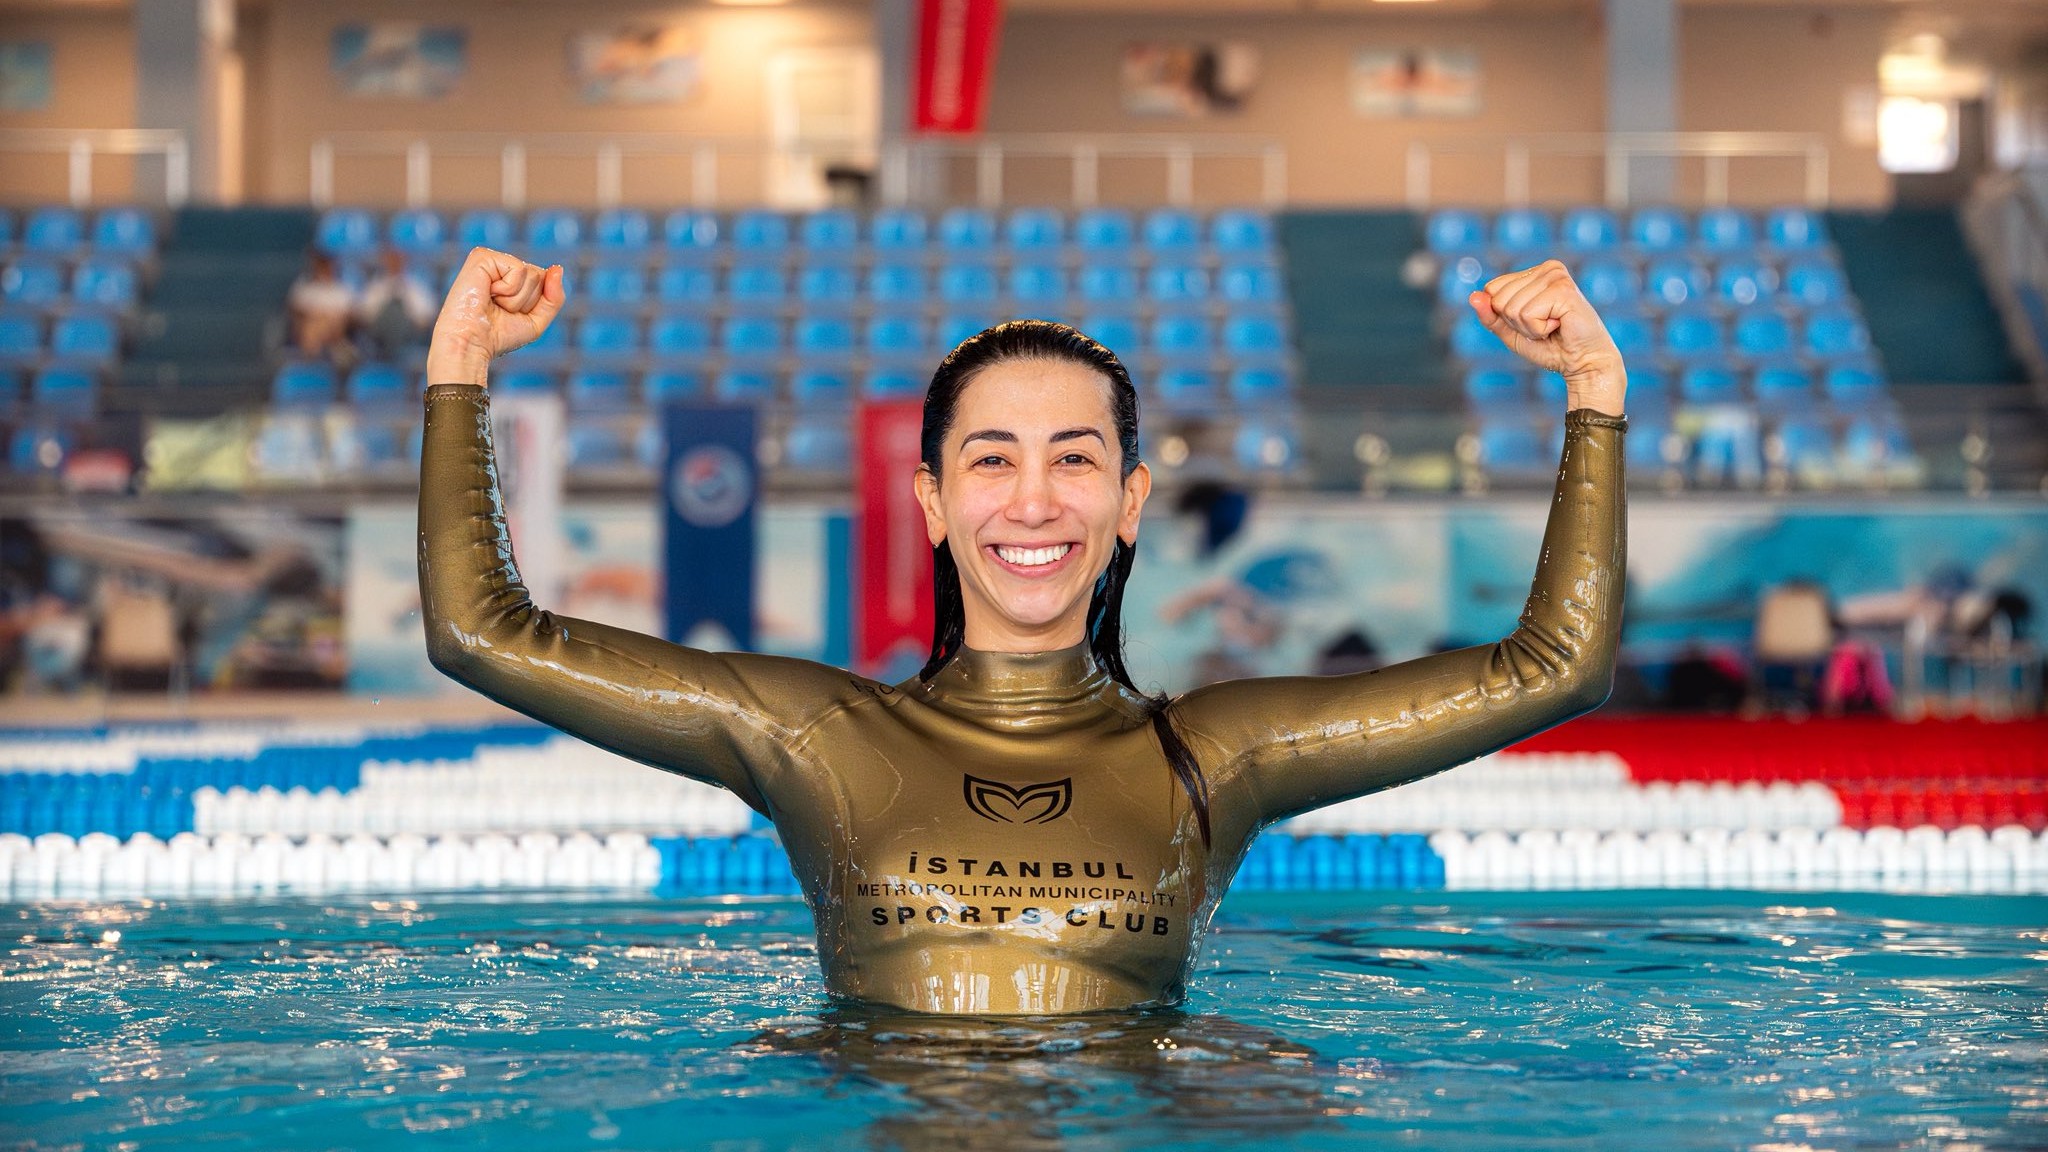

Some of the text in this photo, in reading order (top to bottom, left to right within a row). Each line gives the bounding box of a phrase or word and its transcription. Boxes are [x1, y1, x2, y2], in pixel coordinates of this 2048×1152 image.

[908, 851, 1134, 880] İSTANBUL
[857, 883, 1176, 908] METROPOLITAN MUNICIPALITY
[871, 905, 1169, 936] SPORTS CLUB
